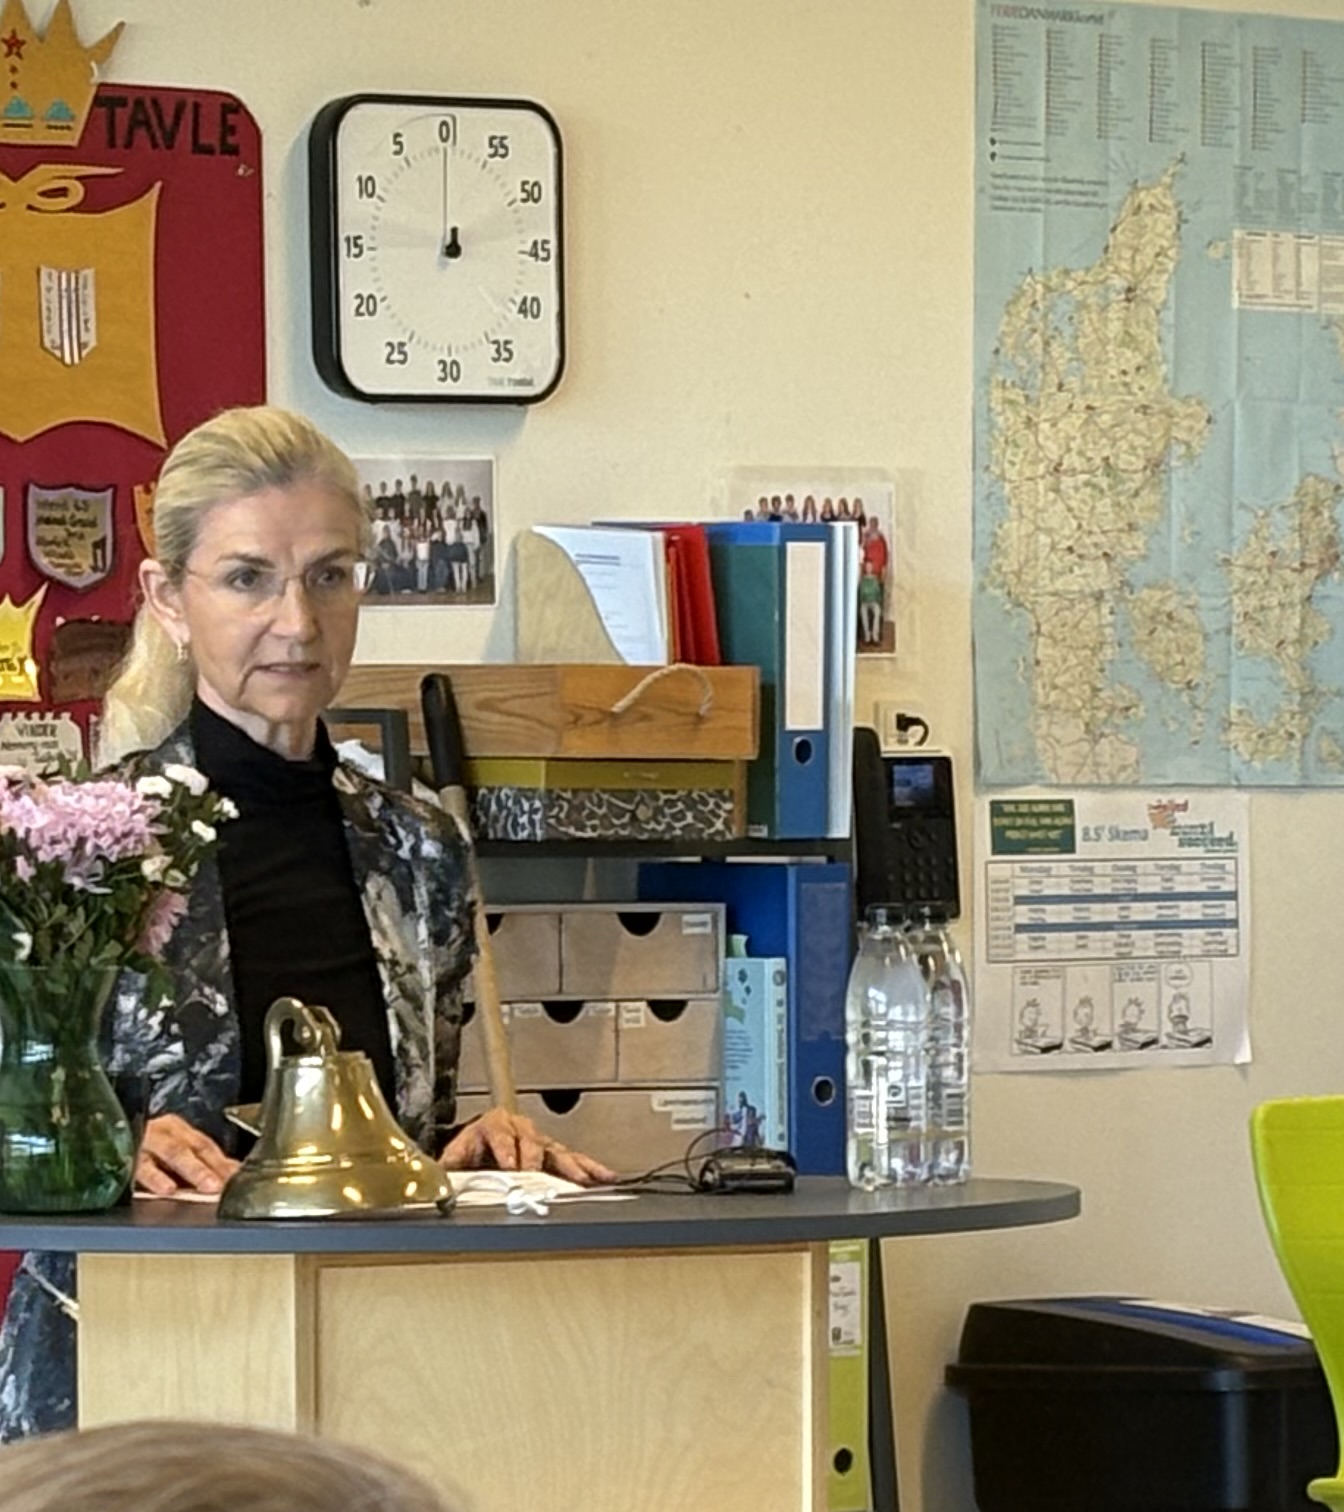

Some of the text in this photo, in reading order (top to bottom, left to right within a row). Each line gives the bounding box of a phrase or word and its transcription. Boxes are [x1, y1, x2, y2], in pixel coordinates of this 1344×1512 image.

[95, 92, 242, 157] TAVLE
[438, 119, 452, 144] 0
[392, 132, 405, 156] 5
[488, 135, 510, 159] 55
[357, 175, 376, 199] 10
[520, 181, 542, 204] 50
[345, 235, 364, 259] 15
[528, 239, 551, 262] 45
[355, 293, 377, 317] 20
[518, 296, 541, 319] 40
[385, 341, 408, 365] 25
[491, 339, 514, 363] 35
[437, 359, 461, 383] 30
